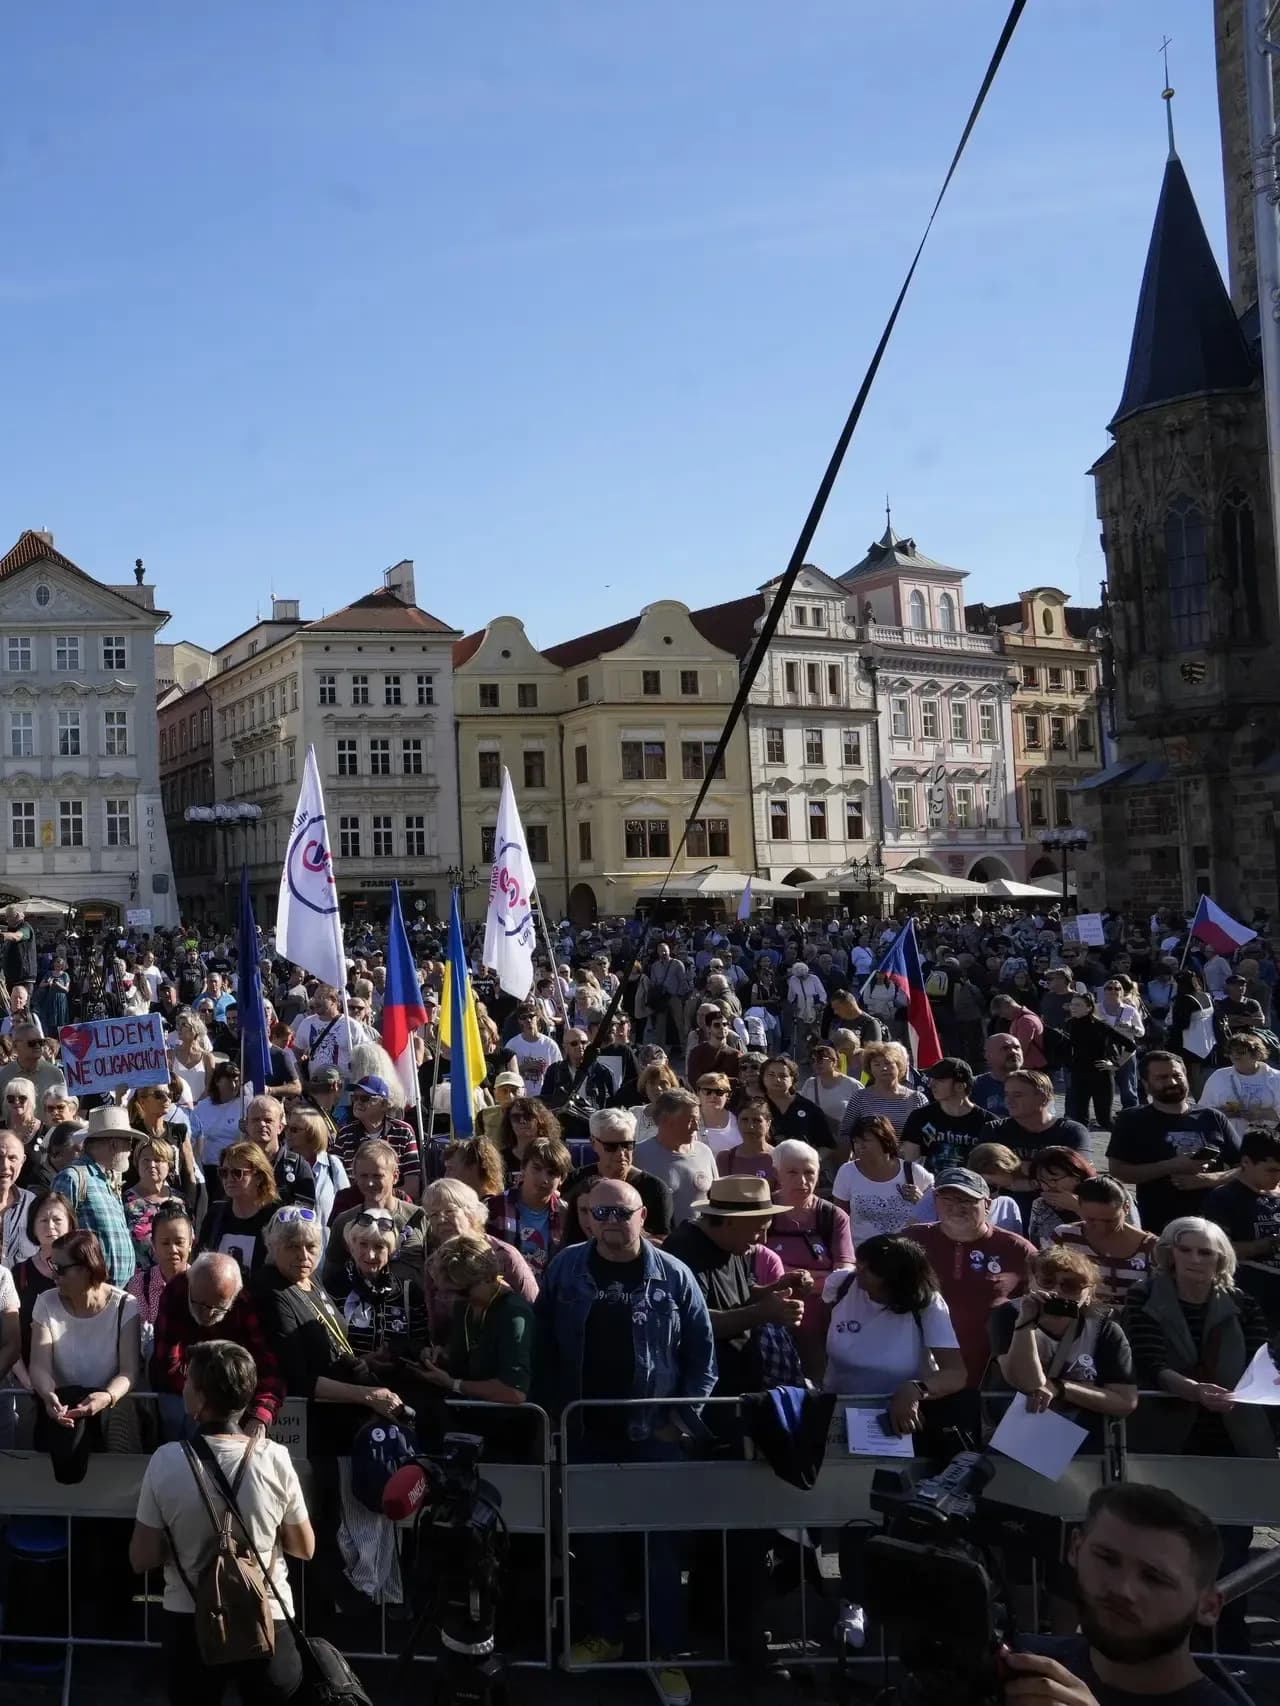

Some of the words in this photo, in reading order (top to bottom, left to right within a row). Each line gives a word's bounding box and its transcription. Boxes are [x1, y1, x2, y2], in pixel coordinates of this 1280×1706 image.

[147, 807, 157, 864] HOTEL
[690, 821, 726, 832] AFE
[93, 1020, 155, 1048] LIDEM
[66, 1060, 92, 1087] NE
[94, 1048, 167, 1076] OLIGARCHŮM
